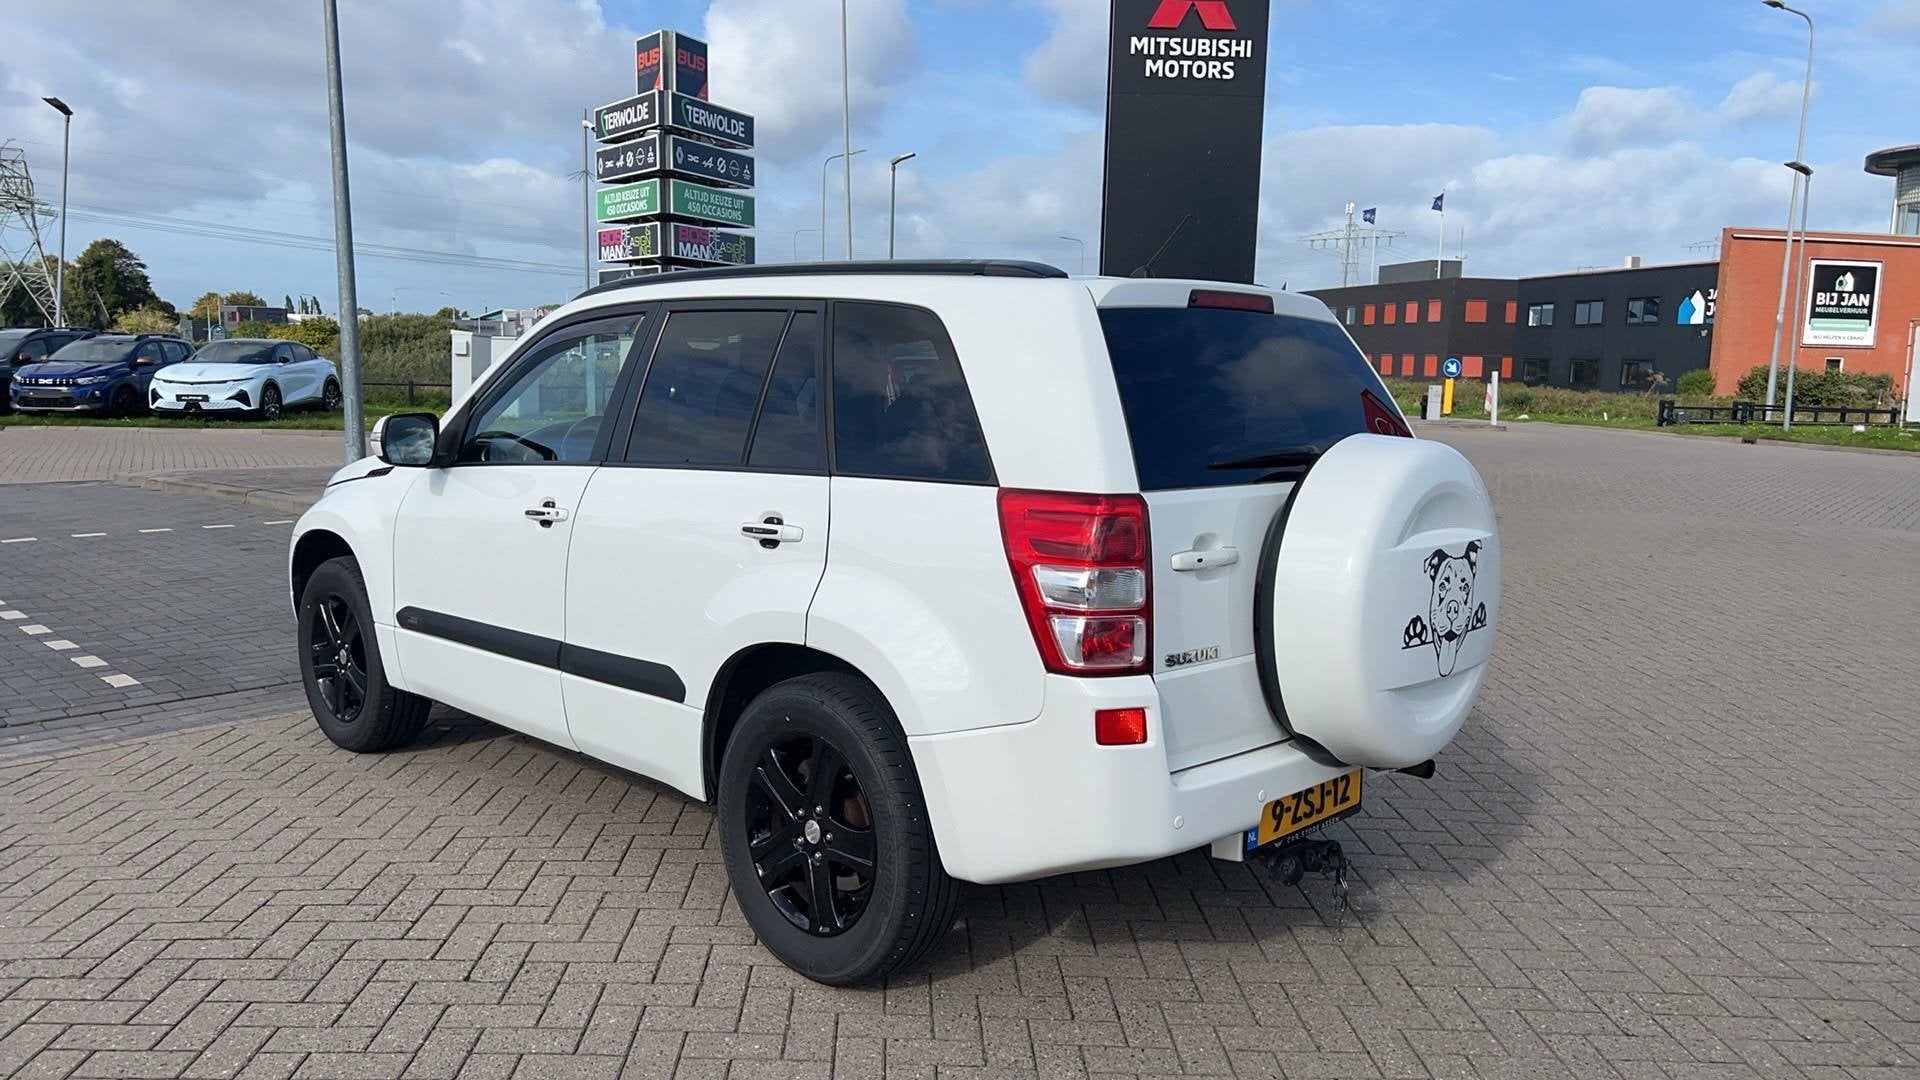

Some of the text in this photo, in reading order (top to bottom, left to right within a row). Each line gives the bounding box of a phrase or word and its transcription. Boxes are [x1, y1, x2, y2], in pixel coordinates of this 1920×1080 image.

[1130, 36, 1252, 58] MITSUBISHI
[638, 48, 660, 70] BUS
[677, 48, 705, 72] BUS
[1145, 59, 1235, 80] MOTORS
[604, 102, 649, 130] TERWOLDE
[686, 104, 745, 138] TERWOLDE
[604, 186, 650, 204] ALTIJD KEUZE UIT
[684, 188, 745, 211] ALTIJD KEUZE UIT
[616, 200, 648, 214] OCCASIONS
[688, 201, 742, 221] 450 OCCASIONS
[601, 245, 623, 260] MAN
[679, 242, 710, 260] MAN
[1815, 306, 1868, 314] MEUBELVERHUUR
[1816, 292, 1870, 307] BIJ JAN
[1165, 645, 1220, 668] SUZUKI
[1271, 774, 1351, 833] 9-ZSJ-12
[1247, 832, 1257, 843] NL
